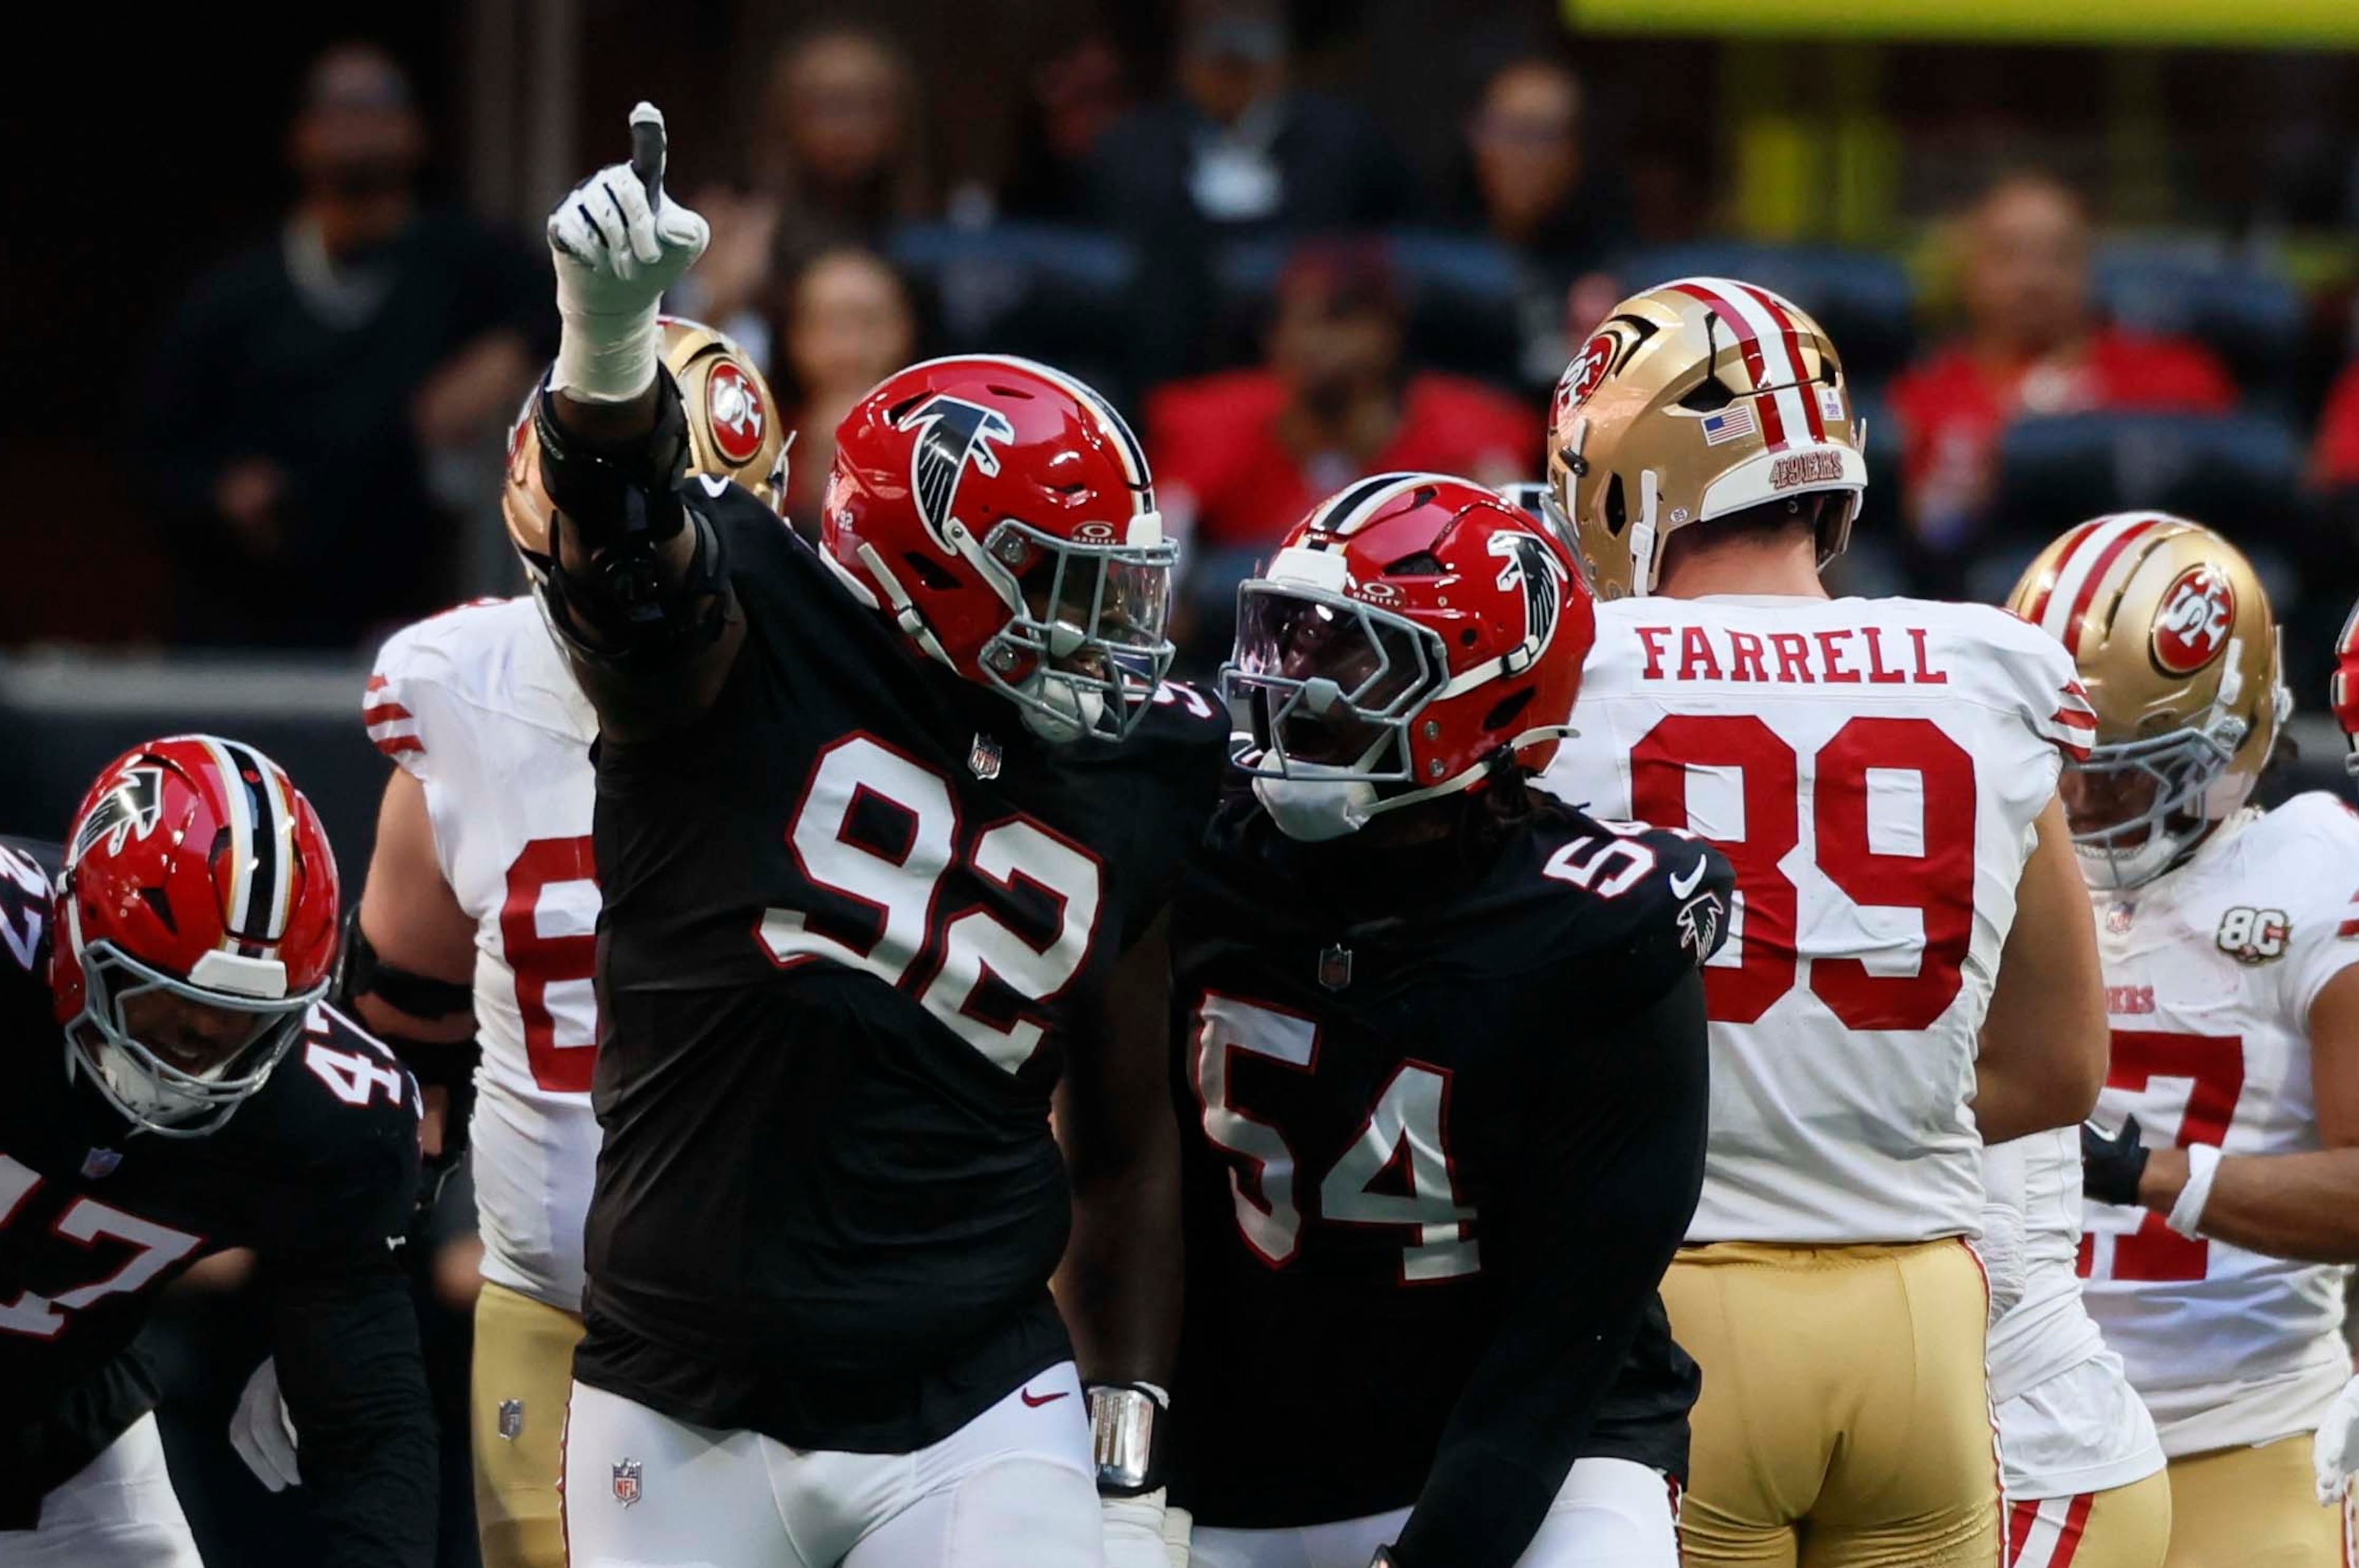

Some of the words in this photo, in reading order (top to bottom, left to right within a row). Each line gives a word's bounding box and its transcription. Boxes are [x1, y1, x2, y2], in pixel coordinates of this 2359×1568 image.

[1769, 451, 1844, 490] 49ERS
[837, 509, 853, 532] 92
[1072, 535, 1117, 545] OAKLEY
[1353, 591, 1401, 607] OAKLEY
[1635, 626, 1947, 684] FARRELL
[1630, 714, 1977, 1031] 89
[751, 729, 1105, 1076] 92
[1195, 988, 1481, 1287] 54
